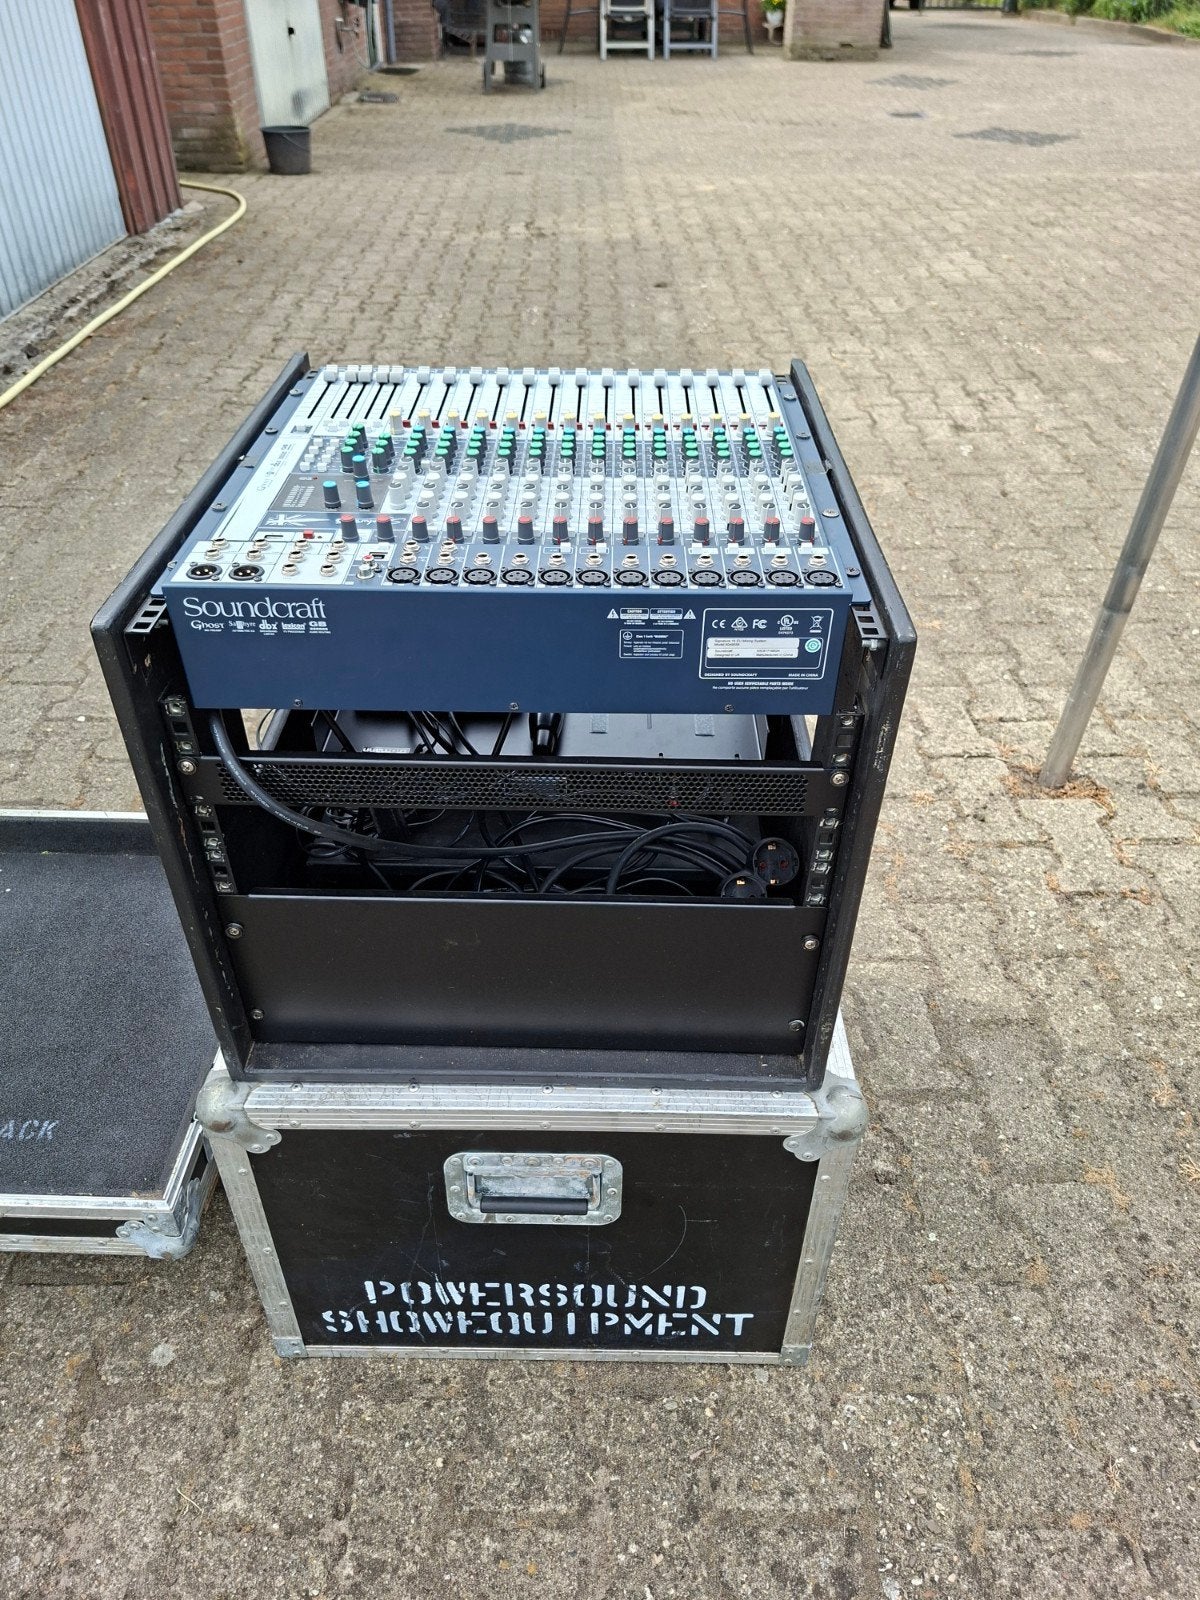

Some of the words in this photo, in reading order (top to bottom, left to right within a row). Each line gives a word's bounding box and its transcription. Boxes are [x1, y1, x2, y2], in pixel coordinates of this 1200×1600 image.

[183, 597, 327, 619] Soundcraft
[259, 619, 278, 629] dbx
[363, 1280, 708, 1310] POWERSOUND
[321, 1310, 755, 1336] SHOWEQUIPMENT
